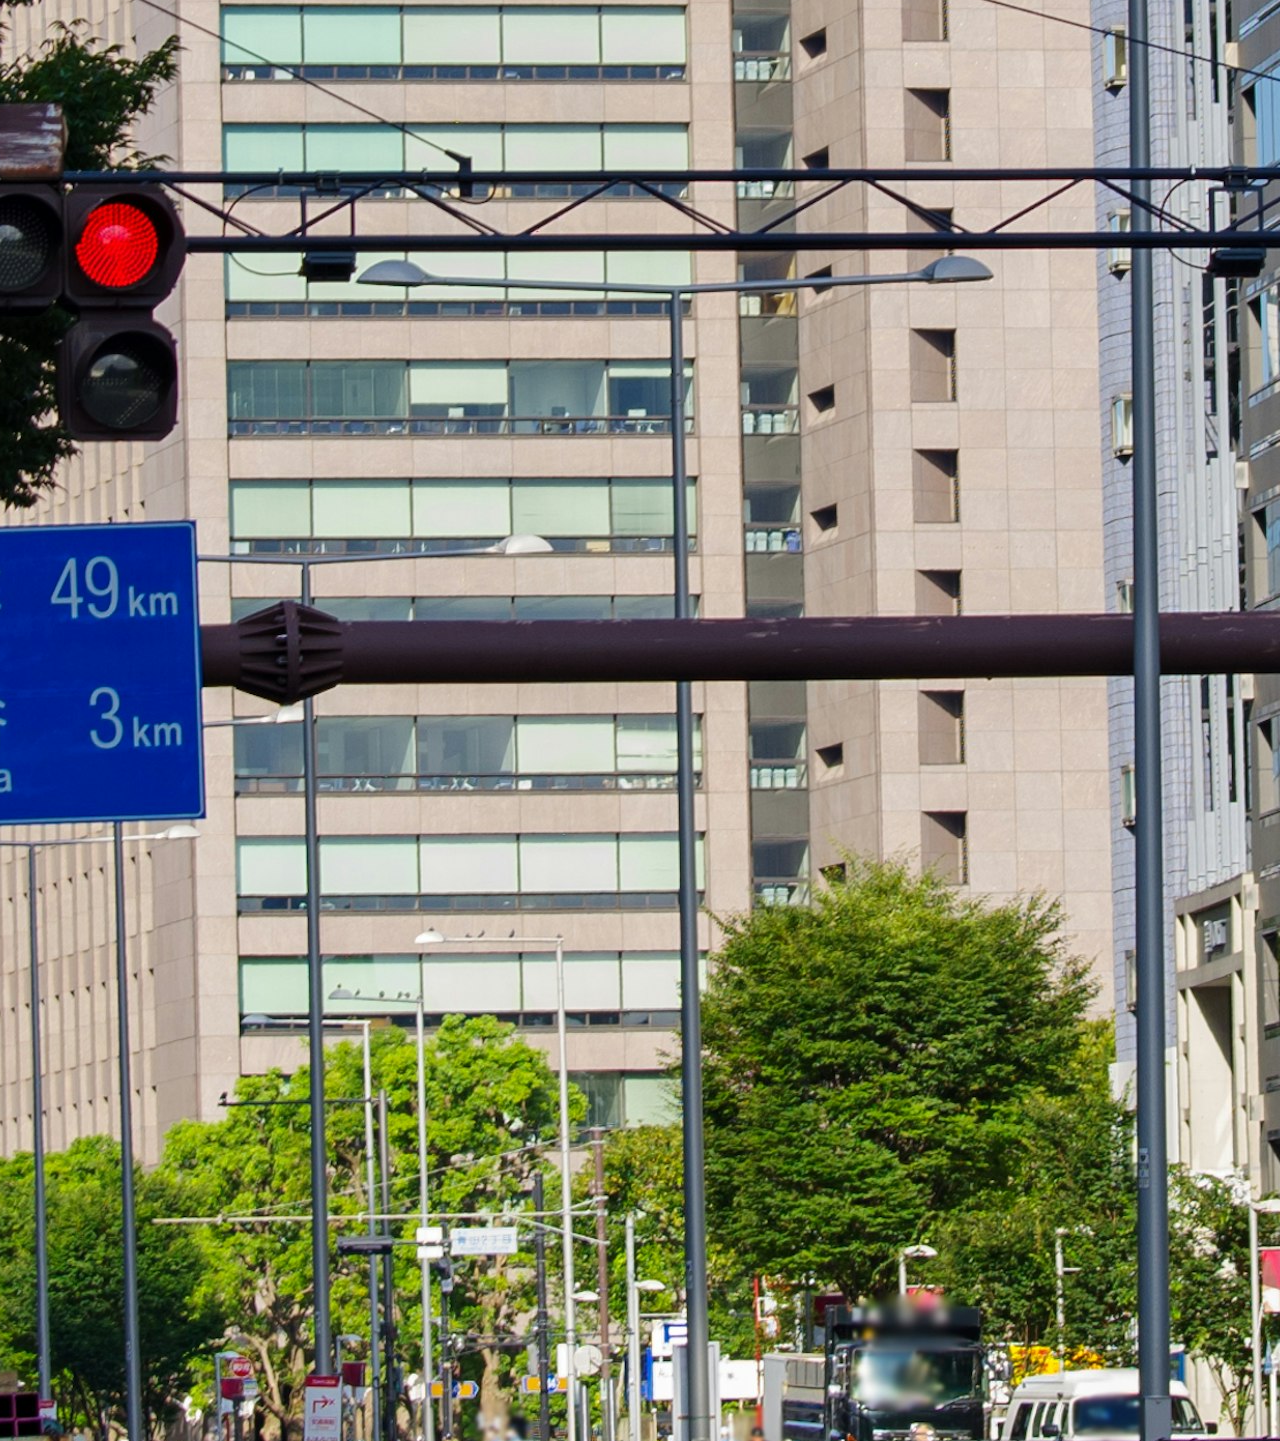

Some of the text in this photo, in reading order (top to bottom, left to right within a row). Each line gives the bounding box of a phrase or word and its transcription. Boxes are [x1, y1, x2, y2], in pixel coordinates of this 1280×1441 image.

[50, 556, 119, 619] 49
[128, 586, 178, 617] km
[89, 686, 123, 750] 3
[133, 717, 182, 748] km
